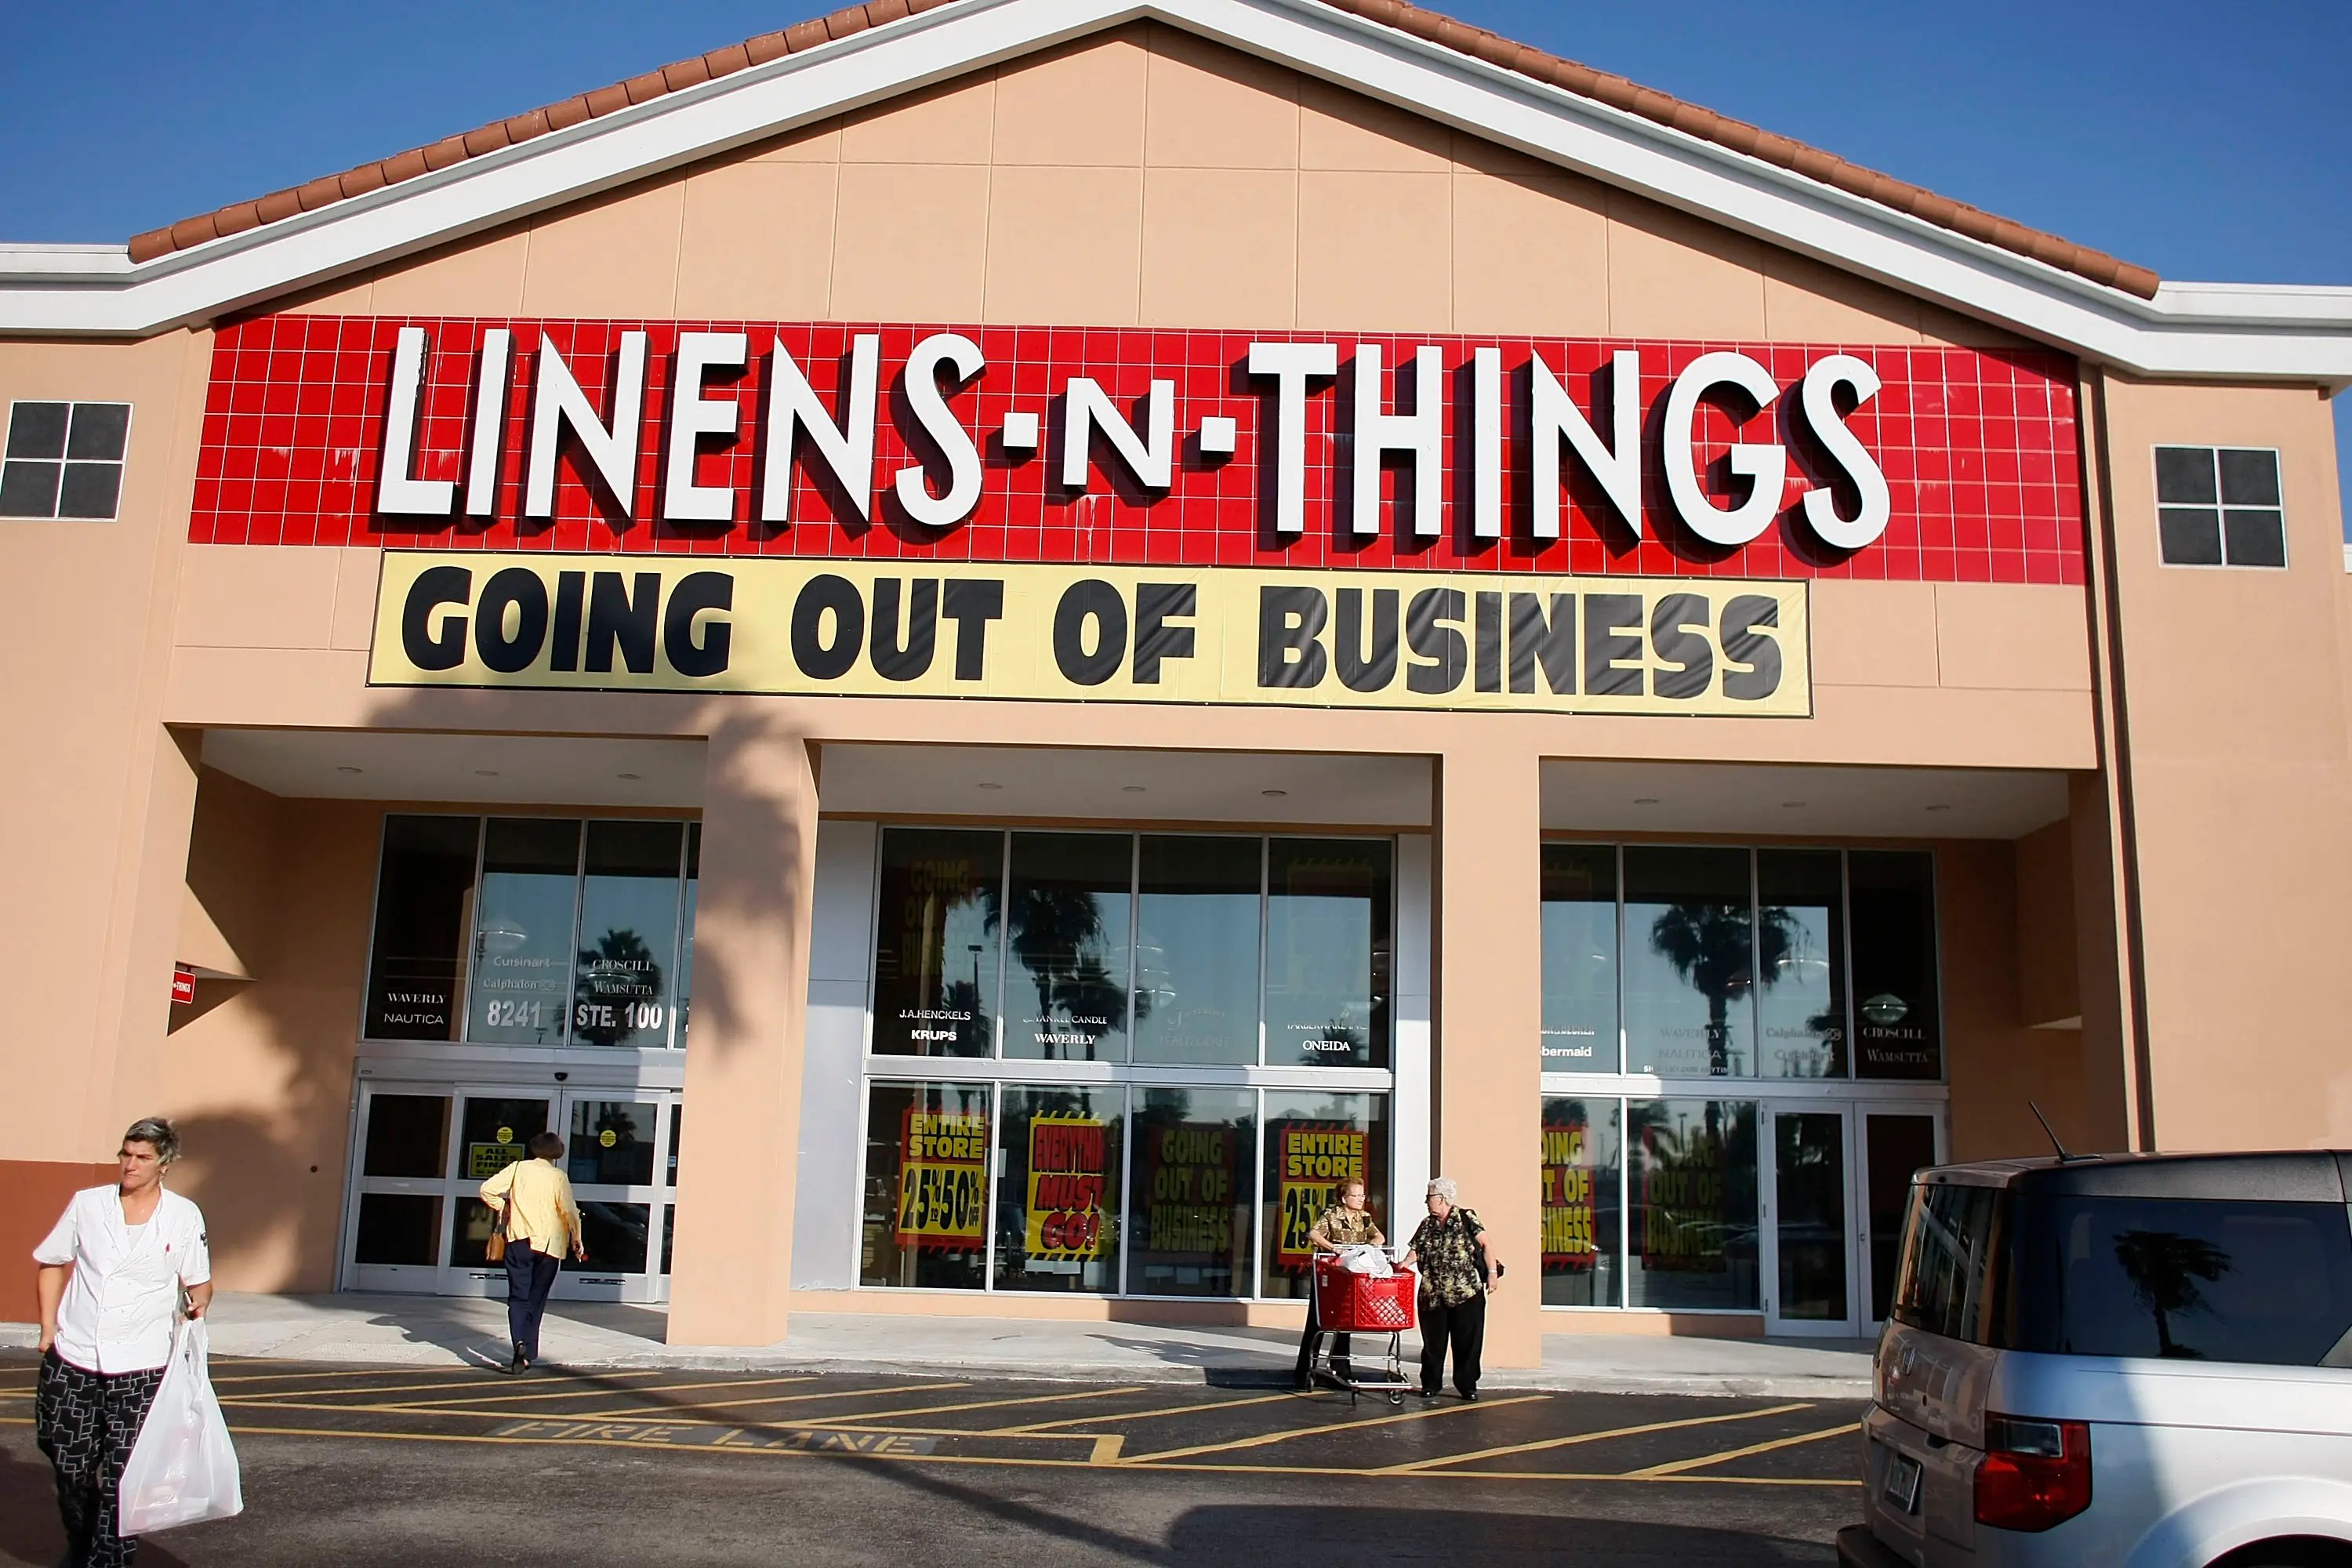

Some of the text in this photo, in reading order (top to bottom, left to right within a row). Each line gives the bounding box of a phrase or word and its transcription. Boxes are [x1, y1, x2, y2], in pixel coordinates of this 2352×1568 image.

[401, 565, 1783, 702] GOING OUT OF BUSINESS
[493, 956, 551, 968] Cuisinart
[592, 959, 654, 972] CROSCILL
[484, 978, 537, 991] Calphalon
[593, 980, 653, 996] WAMSUTTA
[387, 993, 447, 1004] WAVERLY
[383, 1013, 444, 1025] NAUTICA
[487, 999, 543, 1029] 8241
[576, 1004, 617, 1028] STE.
[624, 1002, 663, 1030] 100
[1071, 1014, 1108, 1025] CANDLE
[911, 1029, 957, 1041] KRUPS
[1034, 1033, 1096, 1045] WAVERLY
[1863, 1026, 1926, 1040] CROSCILL
[1302, 1040, 1352, 1051] ONEIDA
[1541, 1045, 1593, 1058] bermaid
[1658, 1048, 1722, 1060] NAUTICA
[1867, 1048, 1929, 1063] WAMSUTTA
[909, 1113, 985, 1137] ENTIRE
[909, 1135, 984, 1159] STORE
[1162, 1129, 1223, 1164] GOING
[1287, 1134, 1363, 1155] ENTIRE
[1541, 1131, 1582, 1165] OING
[1287, 1156, 1363, 1178] STORE
[1035, 1174, 1106, 1212] MUST
[1154, 1167, 1229, 1202] OUT OF
[1563, 1169, 1589, 1203] OF
[1649, 1170, 1722, 1205] OUT OF
[1040, 1212, 1100, 1251] GO!
[1149, 1204, 1230, 1254] BUSINESS
[1541, 1206, 1592, 1254] SINESS
[497, 1421, 934, 1454] FIRE LANE
